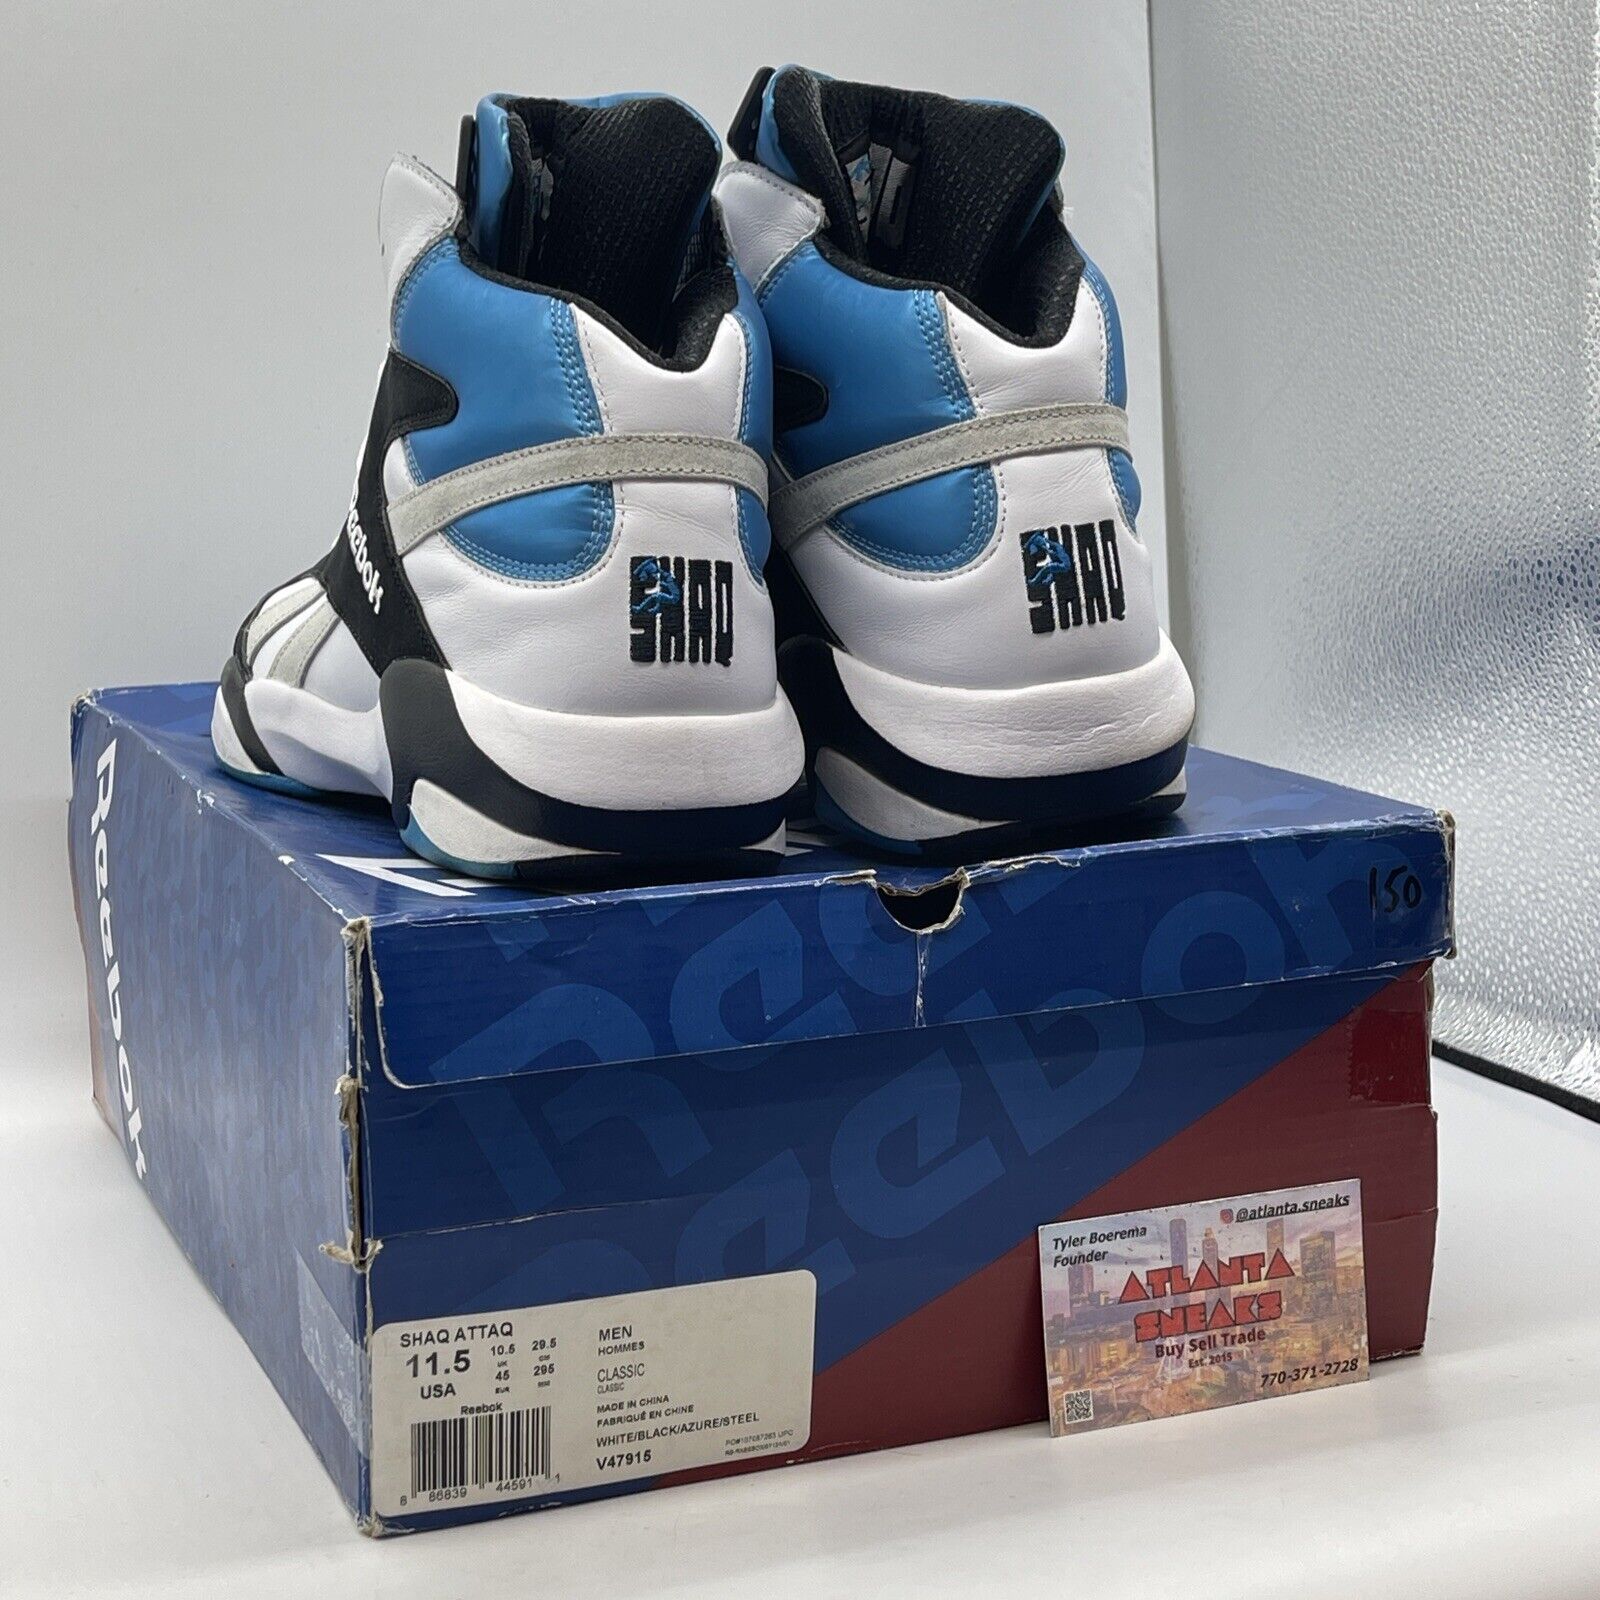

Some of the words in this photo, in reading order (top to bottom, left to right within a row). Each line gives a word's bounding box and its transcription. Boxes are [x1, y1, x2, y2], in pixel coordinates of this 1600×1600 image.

[1019, 518, 1125, 635] SHAQ
[630, 555, 733, 667] SHAQ
[1370, 865, 1421, 913] 150
[91, 739, 147, 1180] Reebok
[1235, 1193, 1350, 1223] @atlanta.sneaks
[1052, 1235, 1086, 1251] Tyler
[1089, 1225, 1147, 1245] Boerema
[1053, 1249, 1108, 1268] Founder
[1119, 1248, 1295, 1304] ATLANTA
[1134, 1291, 1283, 1343] SNEAKS
[400, 1329, 449, 1348] SHAQ
[454, 1322, 513, 1342] ATTAQ
[599, 1325, 633, 1341] MEN
[1155, 1342, 1184, 1361] Buy
[1188, 1336, 1218, 1353] Sell
[1220, 1329, 1266, 1348] Trade
[490, 1343, 515, 1356] 10.5
[598, 1341, 645, 1356] HOMMES
[406, 1349, 471, 1378] 11.5
[597, 1363, 645, 1383] CLASSIC
[1189, 1356, 1206, 1369] Est.
[1261, 1358, 1359, 1388] 770-371-2728
[495, 1370, 510, 1381] 45
[420, 1383, 456, 1400] USA
[597, 1382, 625, 1395] CLASSIC
[461, 1402, 503, 1416] Reebok
[597, 1401, 624, 1414] MADE
[627, 1400, 637, 1409] IN
[639, 1395, 669, 1407] CHINA
[649, 1409, 663, 1419] EN
[664, 1404, 694, 1416] CHINE
[597, 1412, 760, 1448] WHITE/BLACK/AZURE/STEEL
[597, 1449, 652, 1471] V47915
